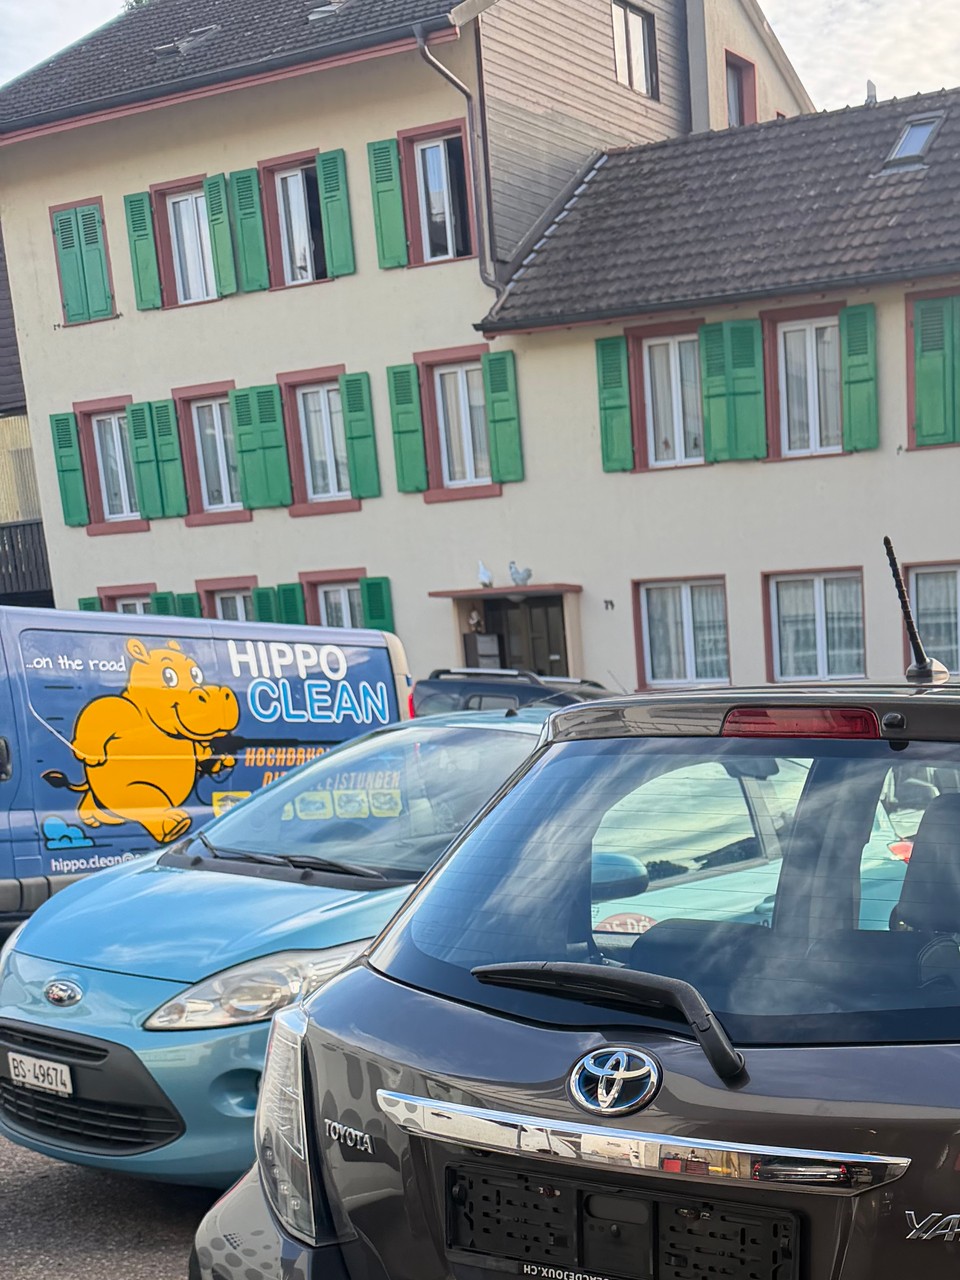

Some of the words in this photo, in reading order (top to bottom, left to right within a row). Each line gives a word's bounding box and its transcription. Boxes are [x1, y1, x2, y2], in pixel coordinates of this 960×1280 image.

[58, 655, 83, 670] the
[88, 655, 126, 672] road
[227, 640, 347, 681] HIPPO
[247, 677, 390, 725] CLEAN
[324, 1118, 374, 1154] TOYOTA
